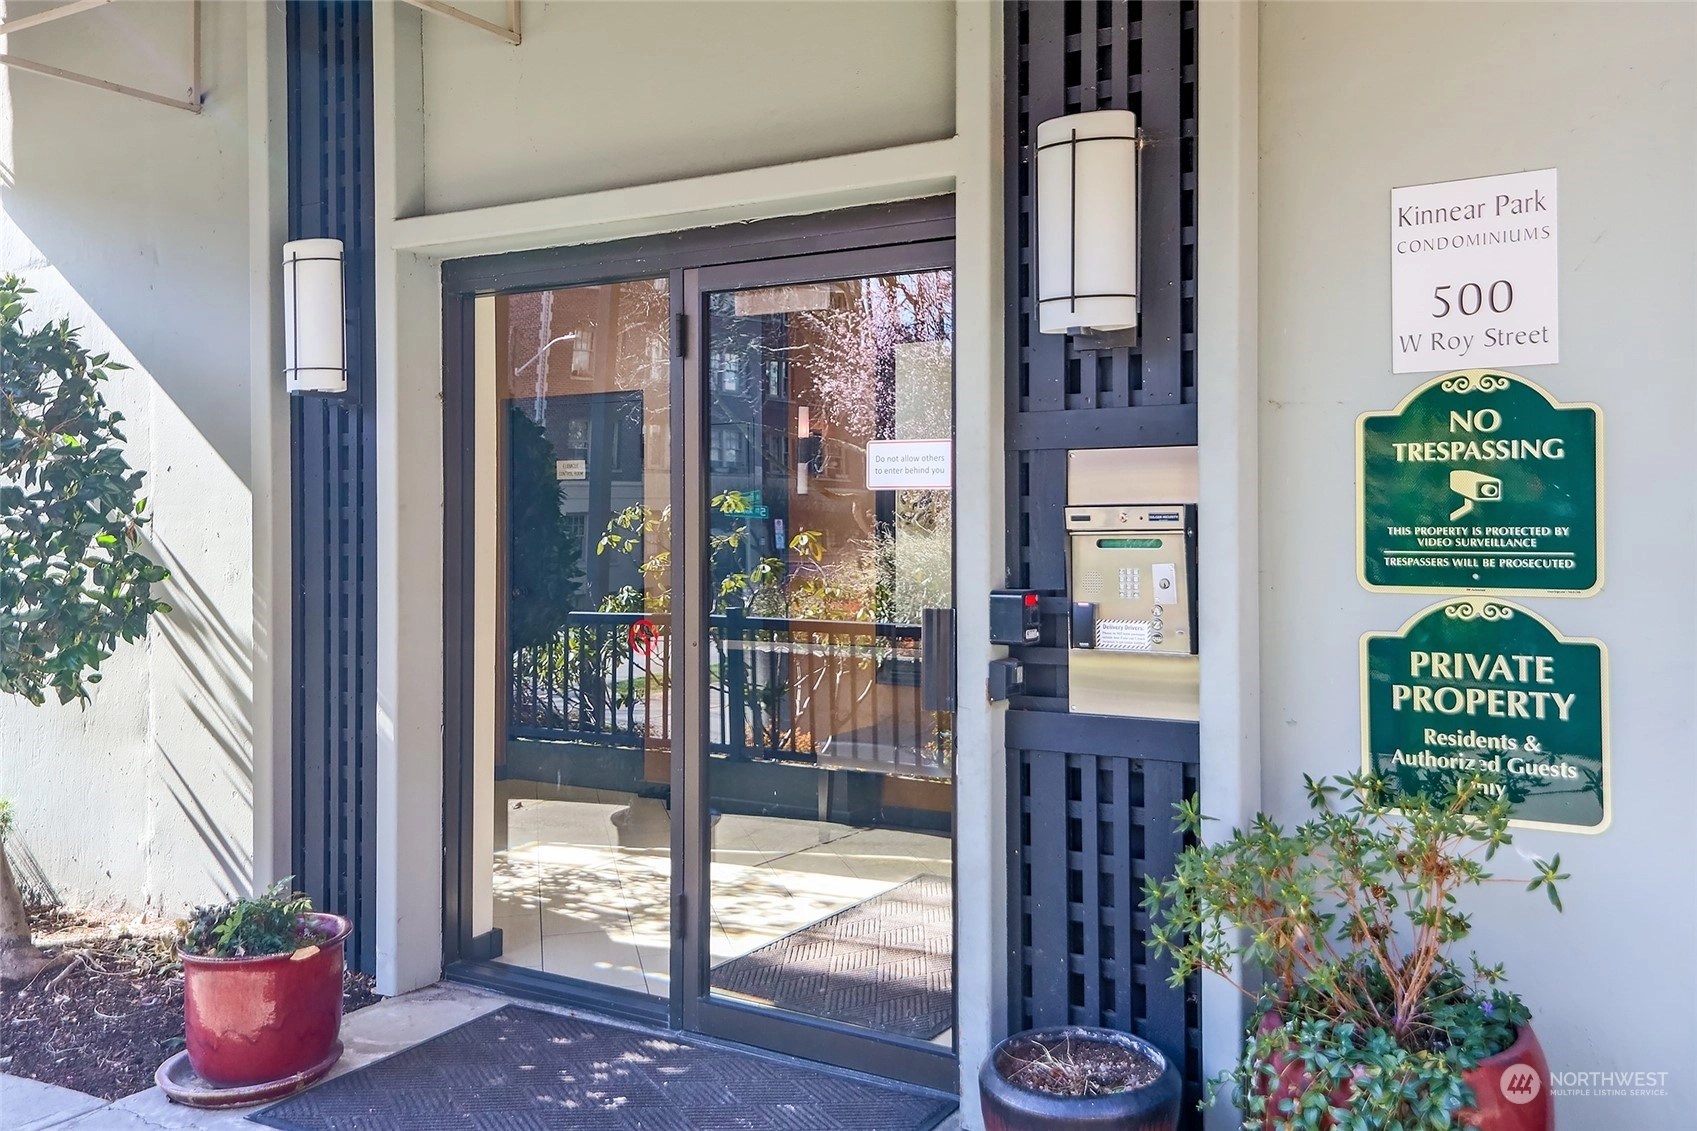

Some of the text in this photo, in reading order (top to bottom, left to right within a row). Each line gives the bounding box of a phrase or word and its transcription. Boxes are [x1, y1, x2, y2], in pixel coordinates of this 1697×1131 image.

[1398, 189, 1547, 227] Kinnear Park
[1397, 225, 1551, 254] CONDOMINIUMS
[1431, 280, 1514, 318] 500
[1400, 326, 1549, 357] W Roy Street
[1450, 408, 1501, 433] NO
[875, 454, 945, 463] Do not allow others
[1392, 438, 1565, 462] TRESPASSING
[875, 466, 945, 476] to enter behind you
[1387, 526, 1569, 537] THIS PROPERTY IS PROTECTED BY
[1417, 537, 1537, 548] VIDEO SURVEILLANCE
[1384, 557, 1575, 569] TRESPASSERS WILL BE PROSECUTED
[1410, 651, 1554, 684] PRIVATE
[1392, 685, 1576, 720] PROPERTY
[1424, 728, 1542, 752] Residents &
[1507, 757, 1578, 778] Guests
[1457, 778, 1506, 801] nly
